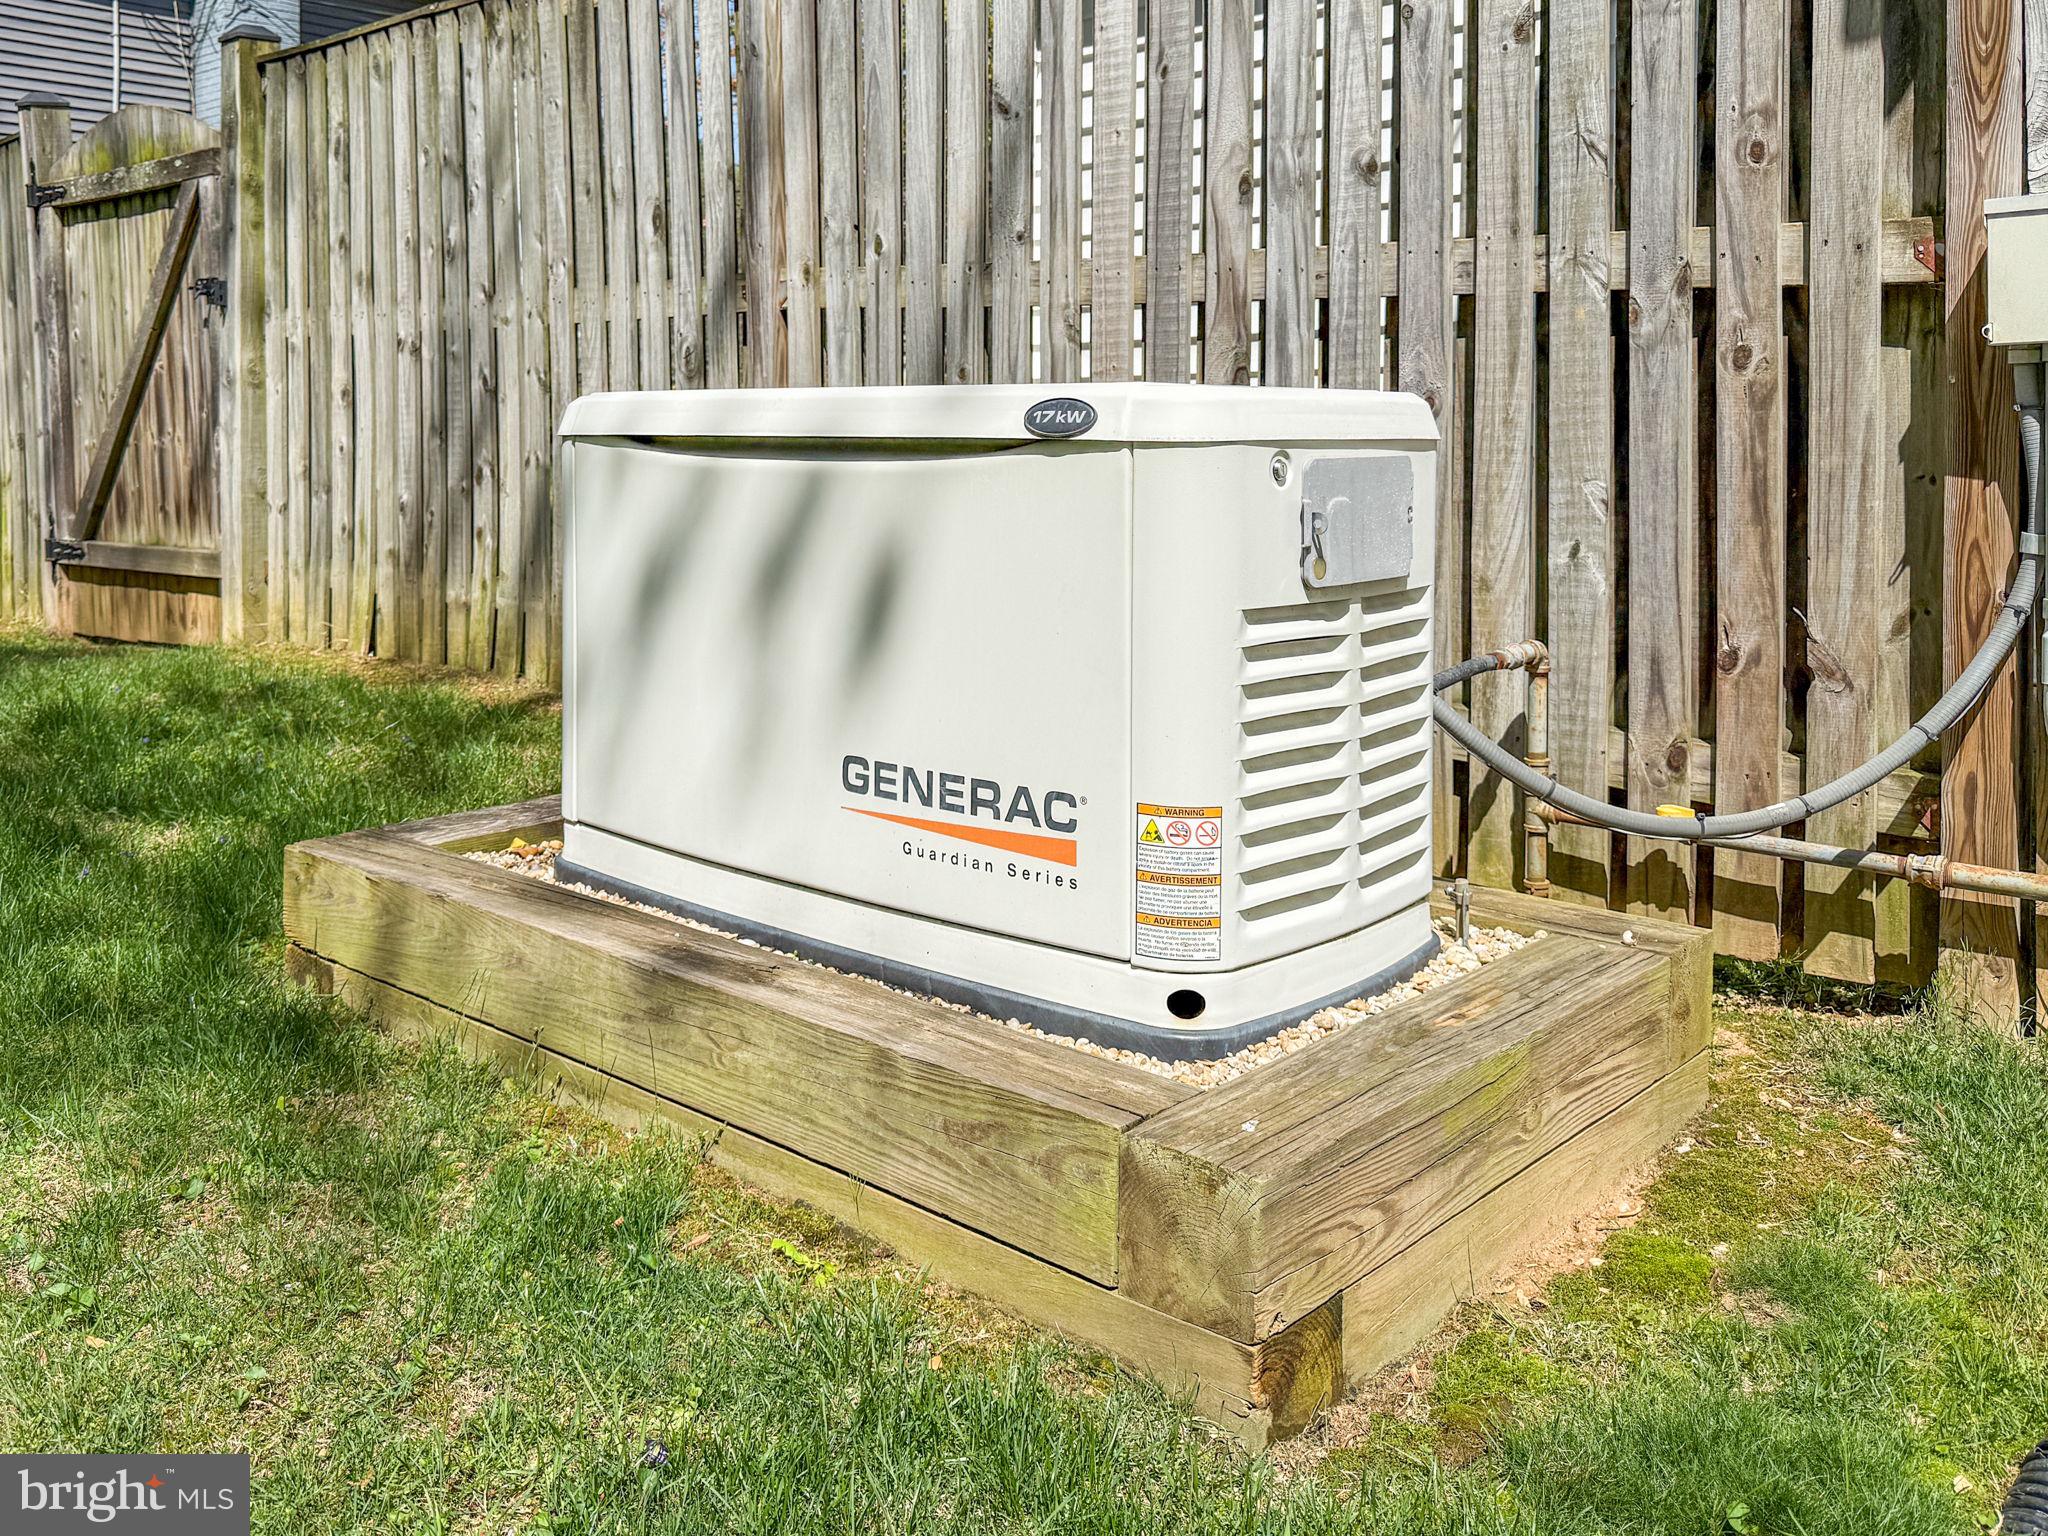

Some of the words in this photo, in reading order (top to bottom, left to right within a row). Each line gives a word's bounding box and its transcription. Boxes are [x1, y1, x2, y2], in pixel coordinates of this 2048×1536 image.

[842, 755, 1078, 833] GENERAC
[1165, 808, 1205, 817] WARNING
[902, 841, 993, 873] Guardian
[1007, 864, 1078, 890] Series
[1149, 874, 1218, 885] AVERTISSEMENT
[1153, 917, 1213, 927] ADVERTENCIA
